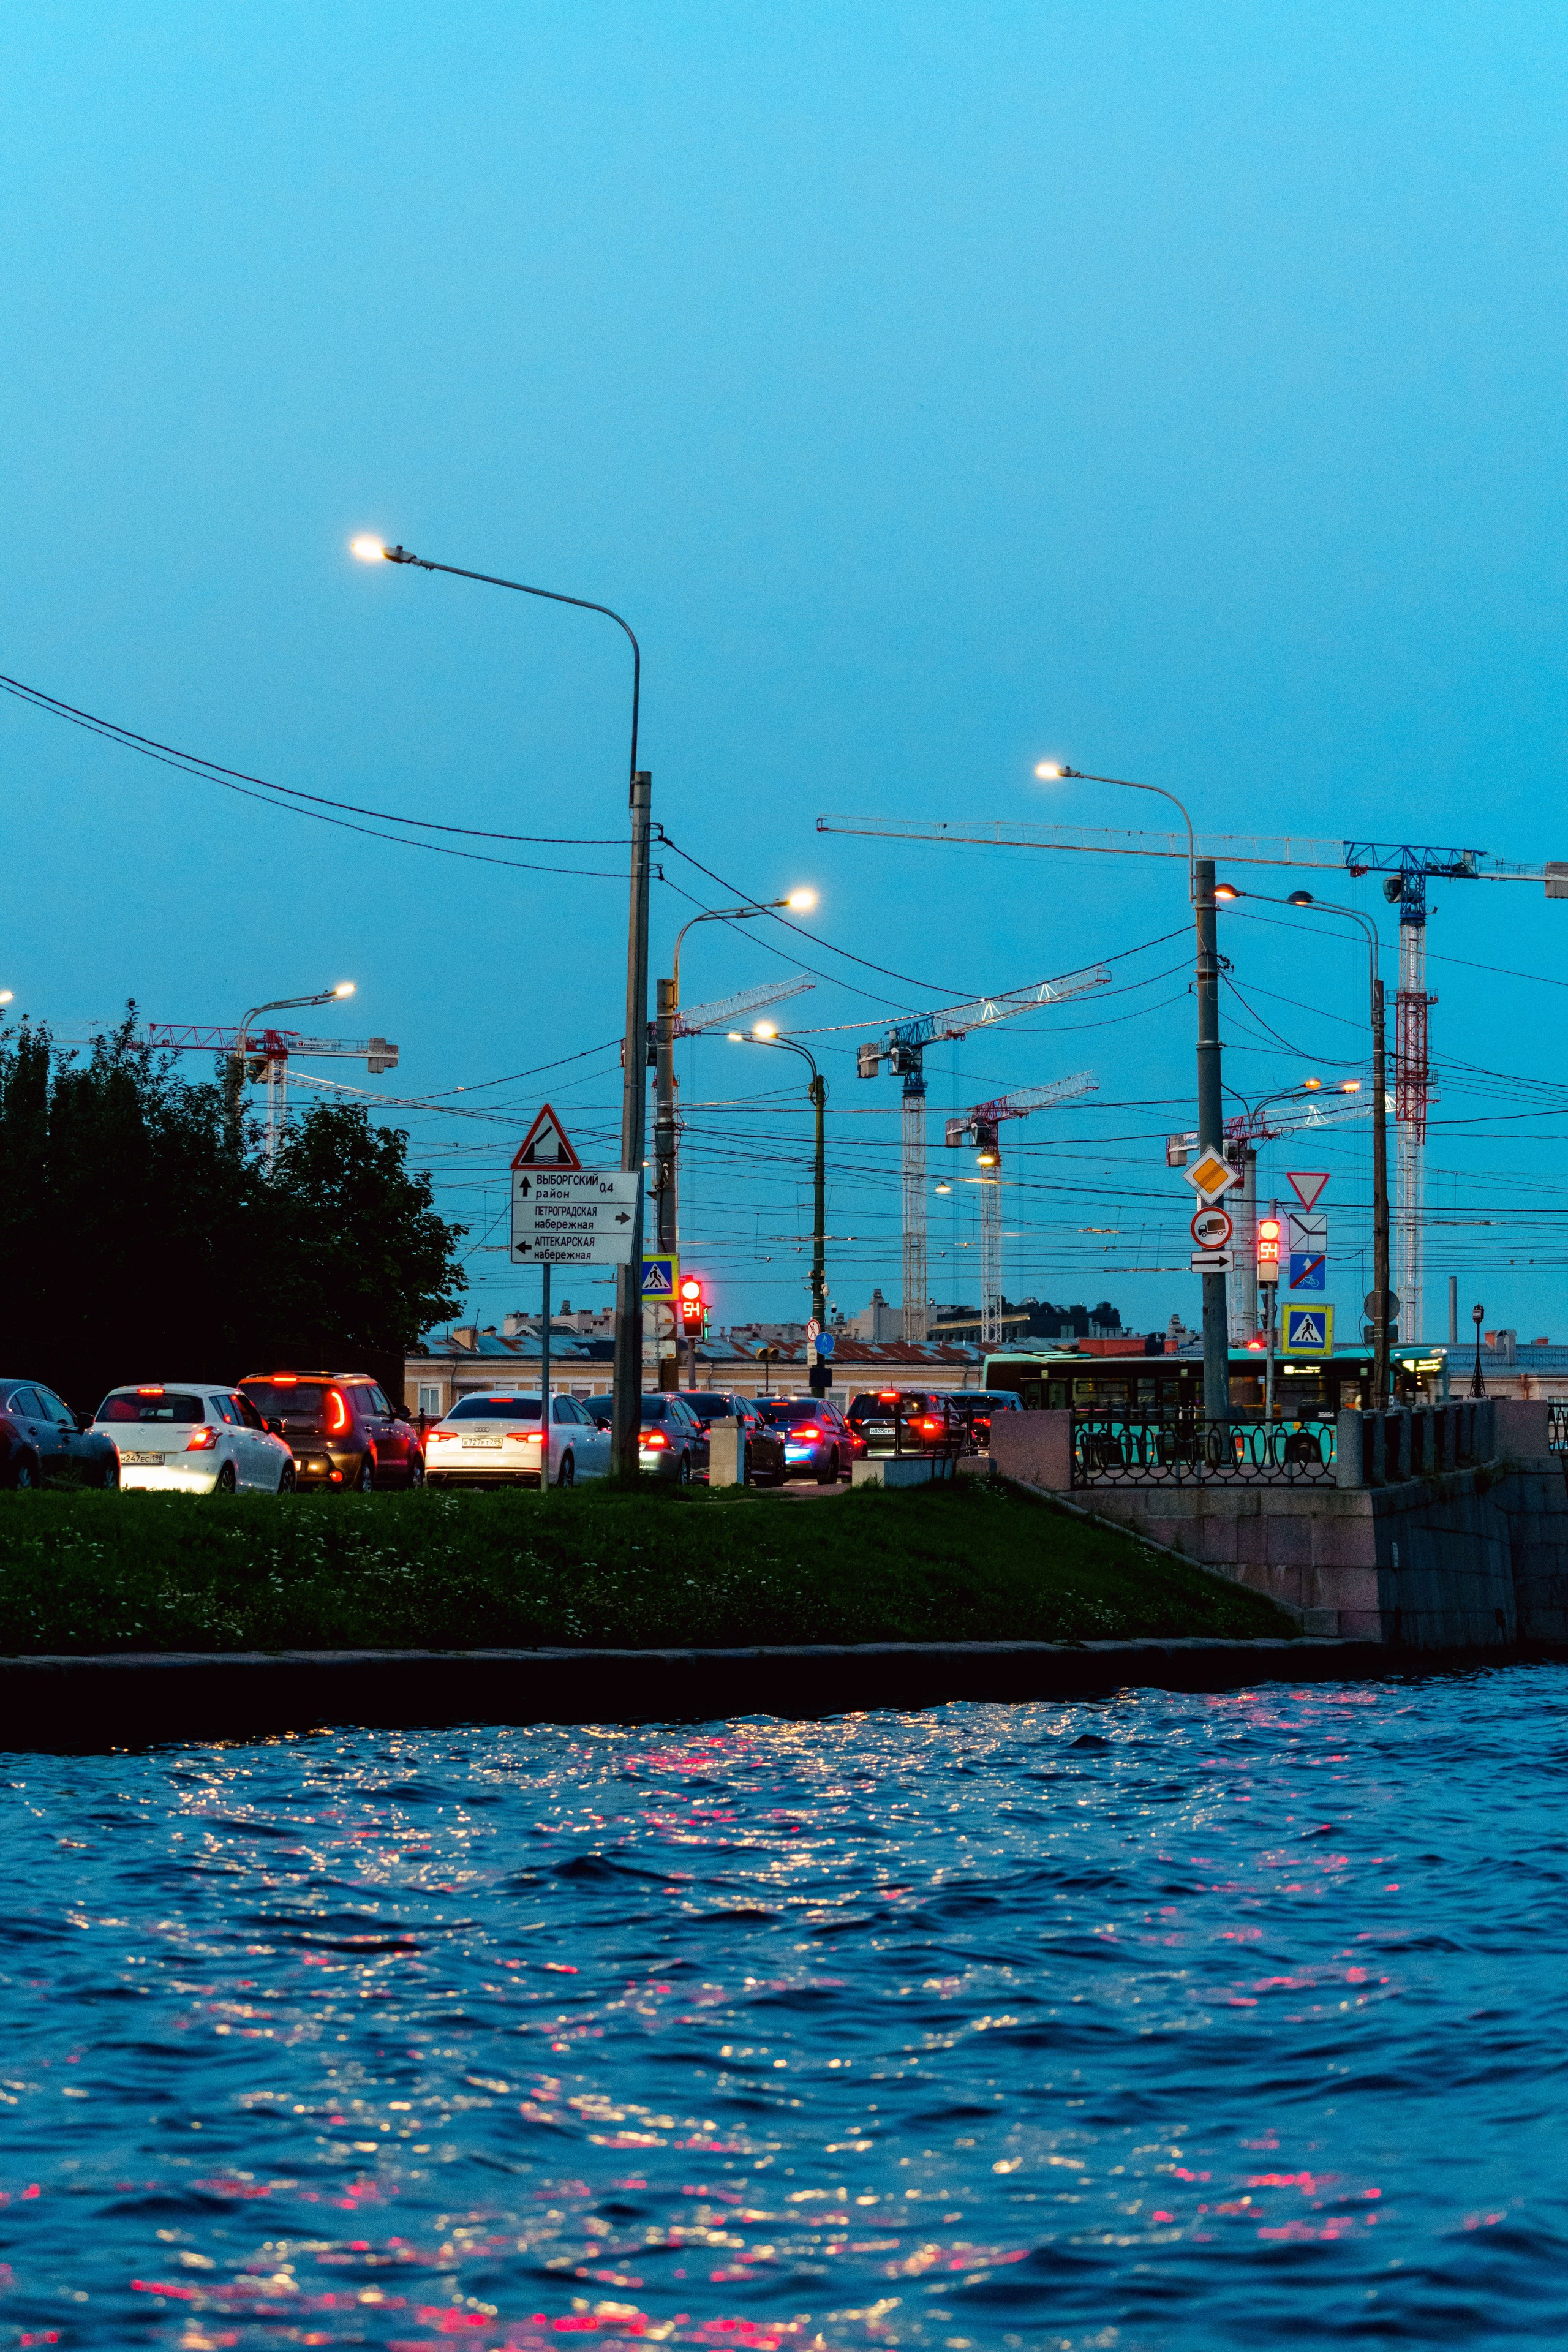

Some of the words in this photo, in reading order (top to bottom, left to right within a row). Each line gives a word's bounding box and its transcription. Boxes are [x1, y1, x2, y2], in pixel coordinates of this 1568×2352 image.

[537, 1173, 598, 1186] ВЫБОРГСКИЙ
[600, 1182, 614, 1193] 0,4
[536, 1188, 570, 1200] район
[535, 1206, 597, 1218] ПЕТРОГРАДСКАЯ
[535, 1219, 594, 1231] набережная
[535, 1236, 595, 1247] АПТЕКАРСКАЯ
[534, 1250, 591, 1262] набережная
[1260, 1242, 1278, 1259] 54
[683, 1302, 700, 1317] 54
